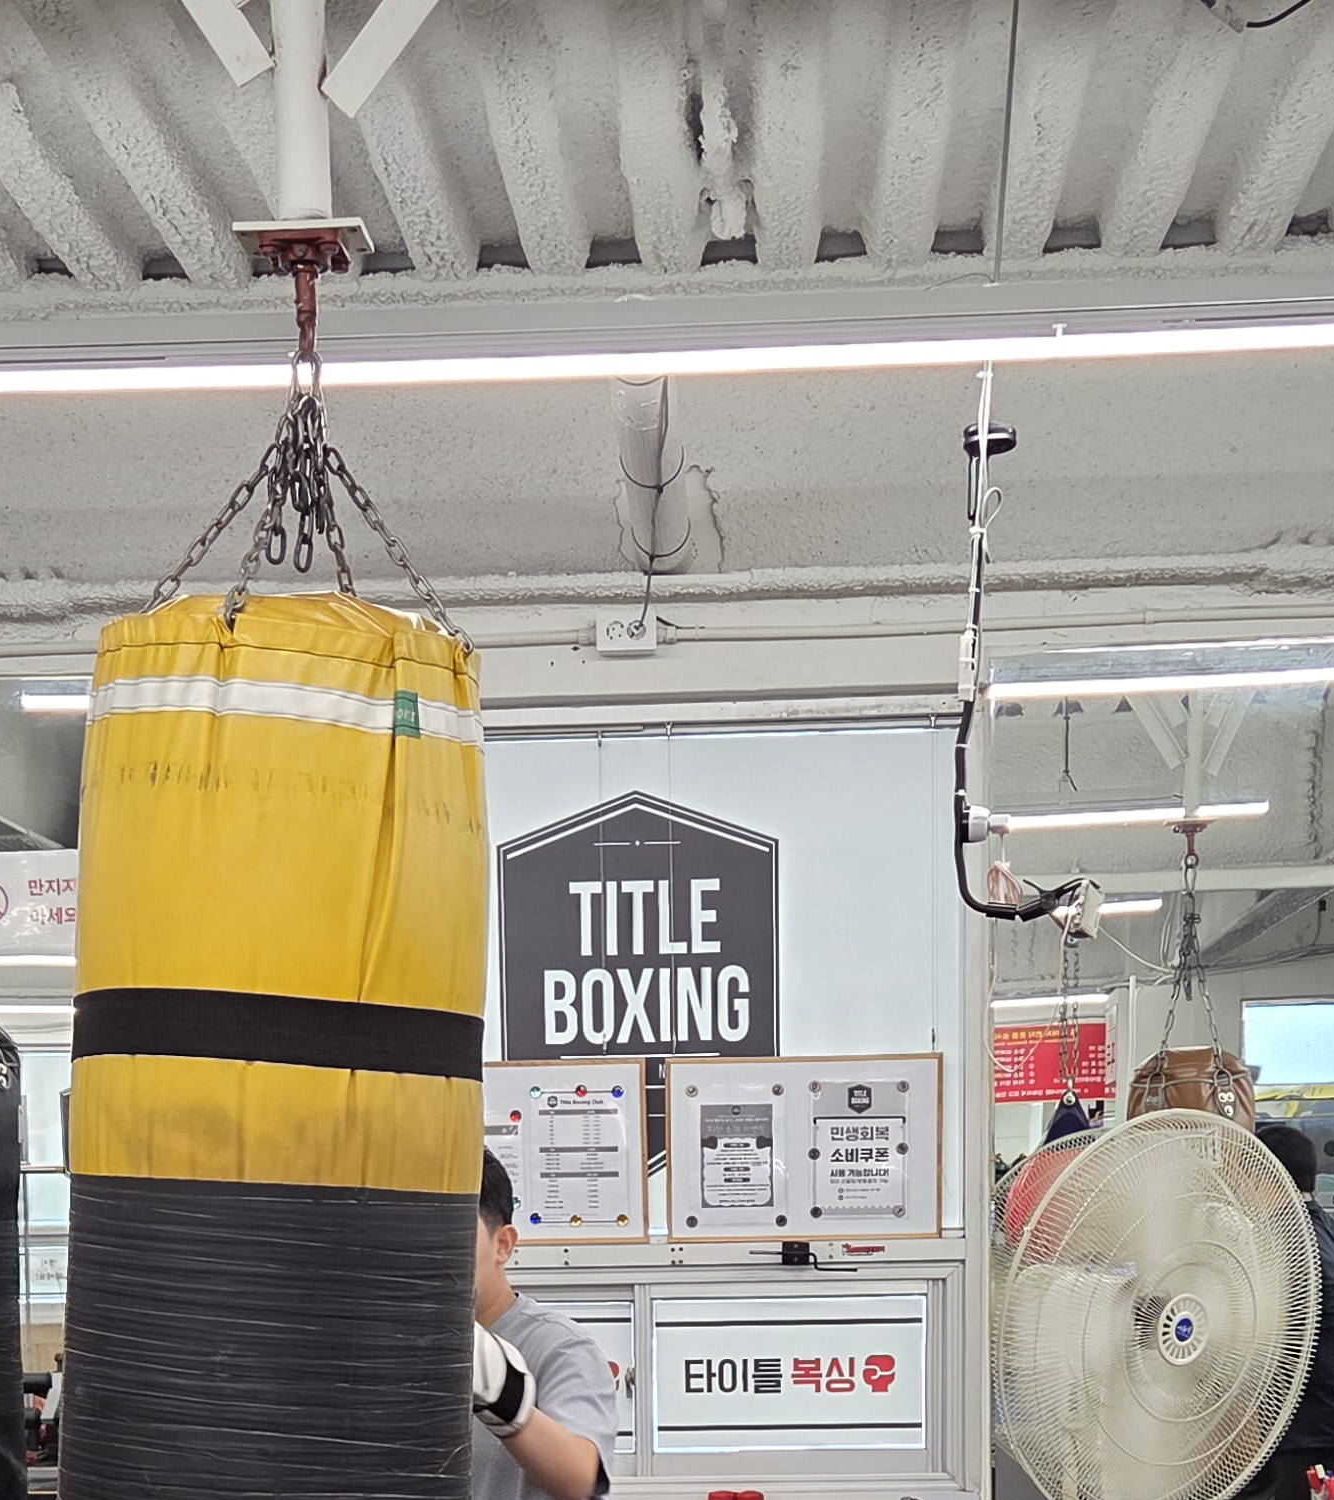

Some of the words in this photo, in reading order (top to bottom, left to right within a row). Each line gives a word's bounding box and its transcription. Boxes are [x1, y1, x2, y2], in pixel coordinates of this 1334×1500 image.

[568, 878, 721, 956] TITLE
[544, 964, 750, 1045] BOXING
[830, 1126, 889, 1141] 민생회복
[830, 1147, 890, 1163] 소비쿠폰
[684, 1358, 783, 1394] 타이틀
[791, 1357, 855, 1393] 복싱
